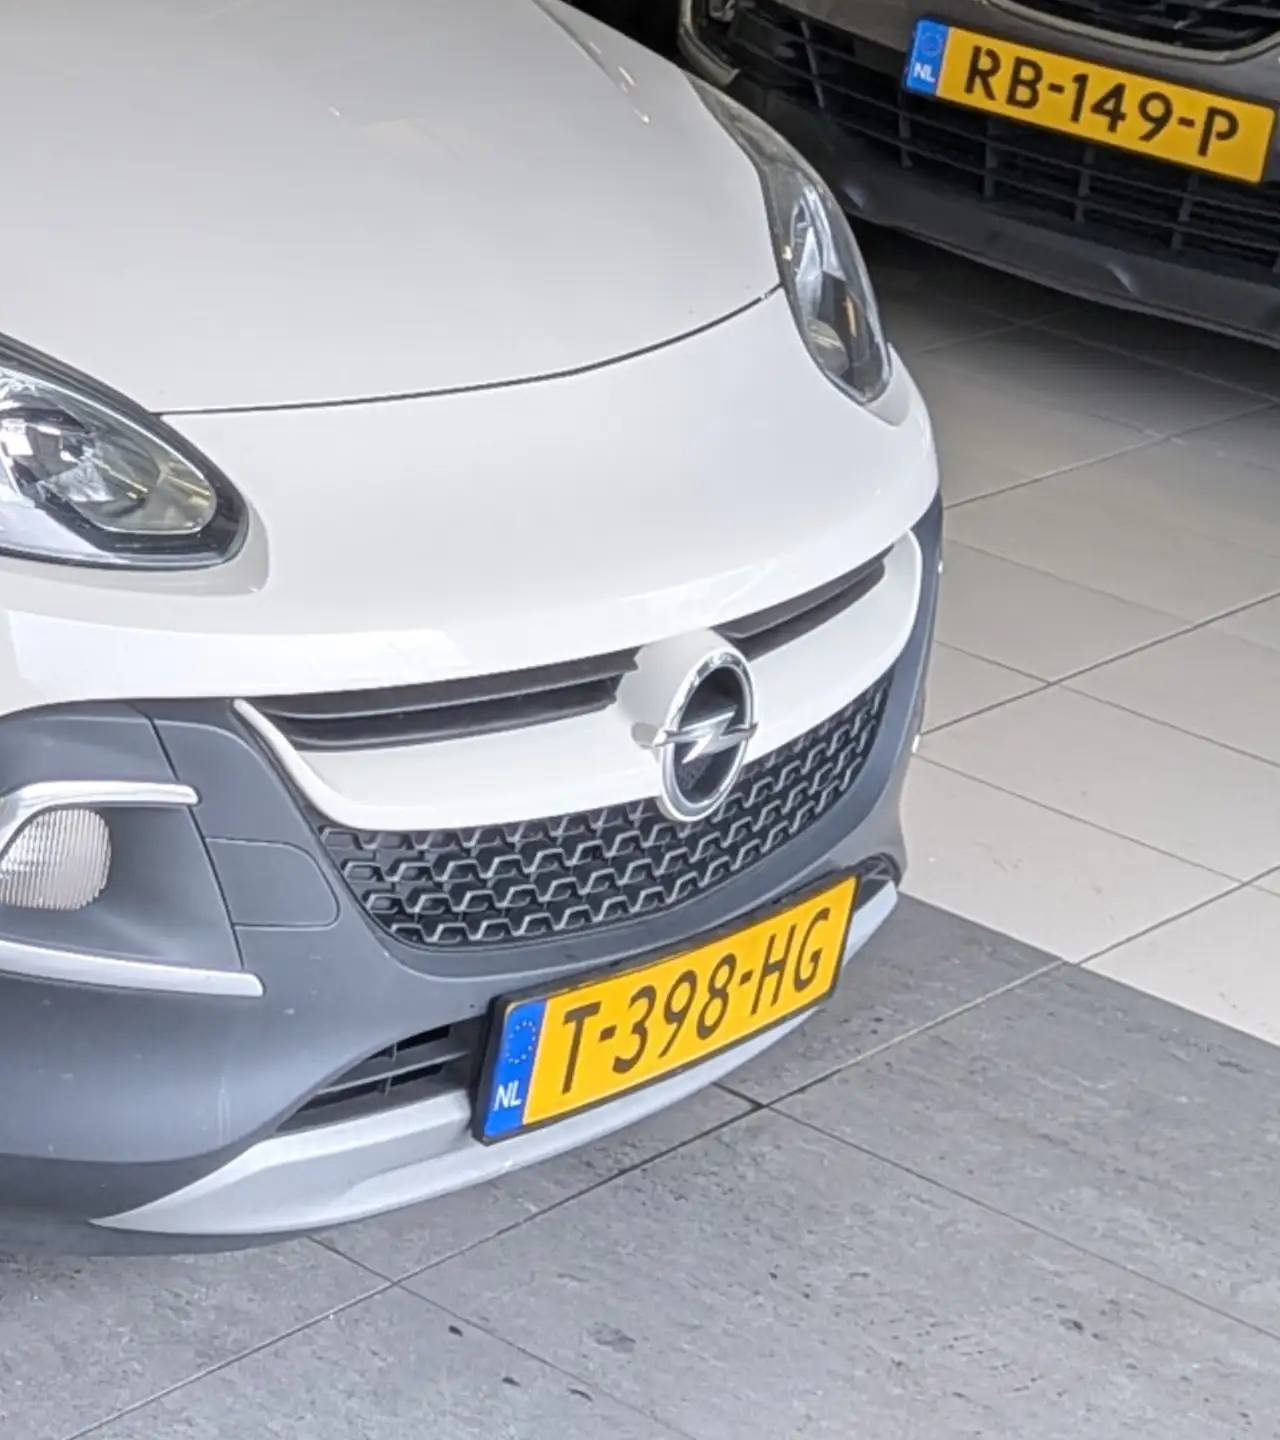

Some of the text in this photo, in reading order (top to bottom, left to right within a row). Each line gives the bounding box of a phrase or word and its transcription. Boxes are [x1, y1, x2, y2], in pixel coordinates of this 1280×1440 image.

[912, 44, 1240, 157] NL RB-149-P
[493, 906, 832, 1112] NL T-398-HG
